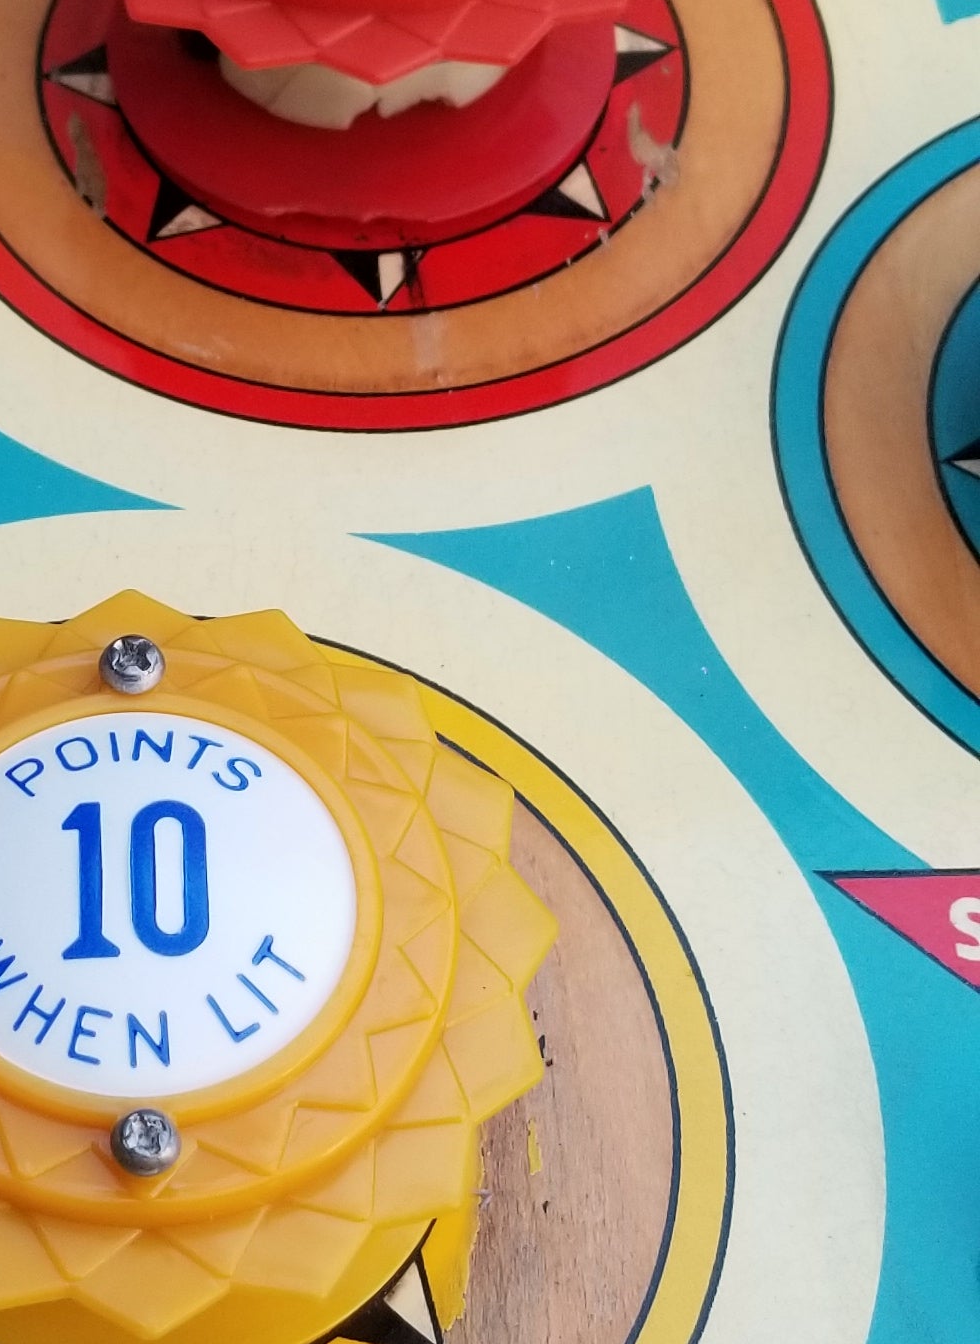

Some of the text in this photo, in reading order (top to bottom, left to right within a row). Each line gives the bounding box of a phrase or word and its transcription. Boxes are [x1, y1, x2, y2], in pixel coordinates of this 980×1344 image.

[4, 729, 263, 798] POINTS
[60, 799, 210, 961] 10
[206, 934, 306, 1044] LIT
